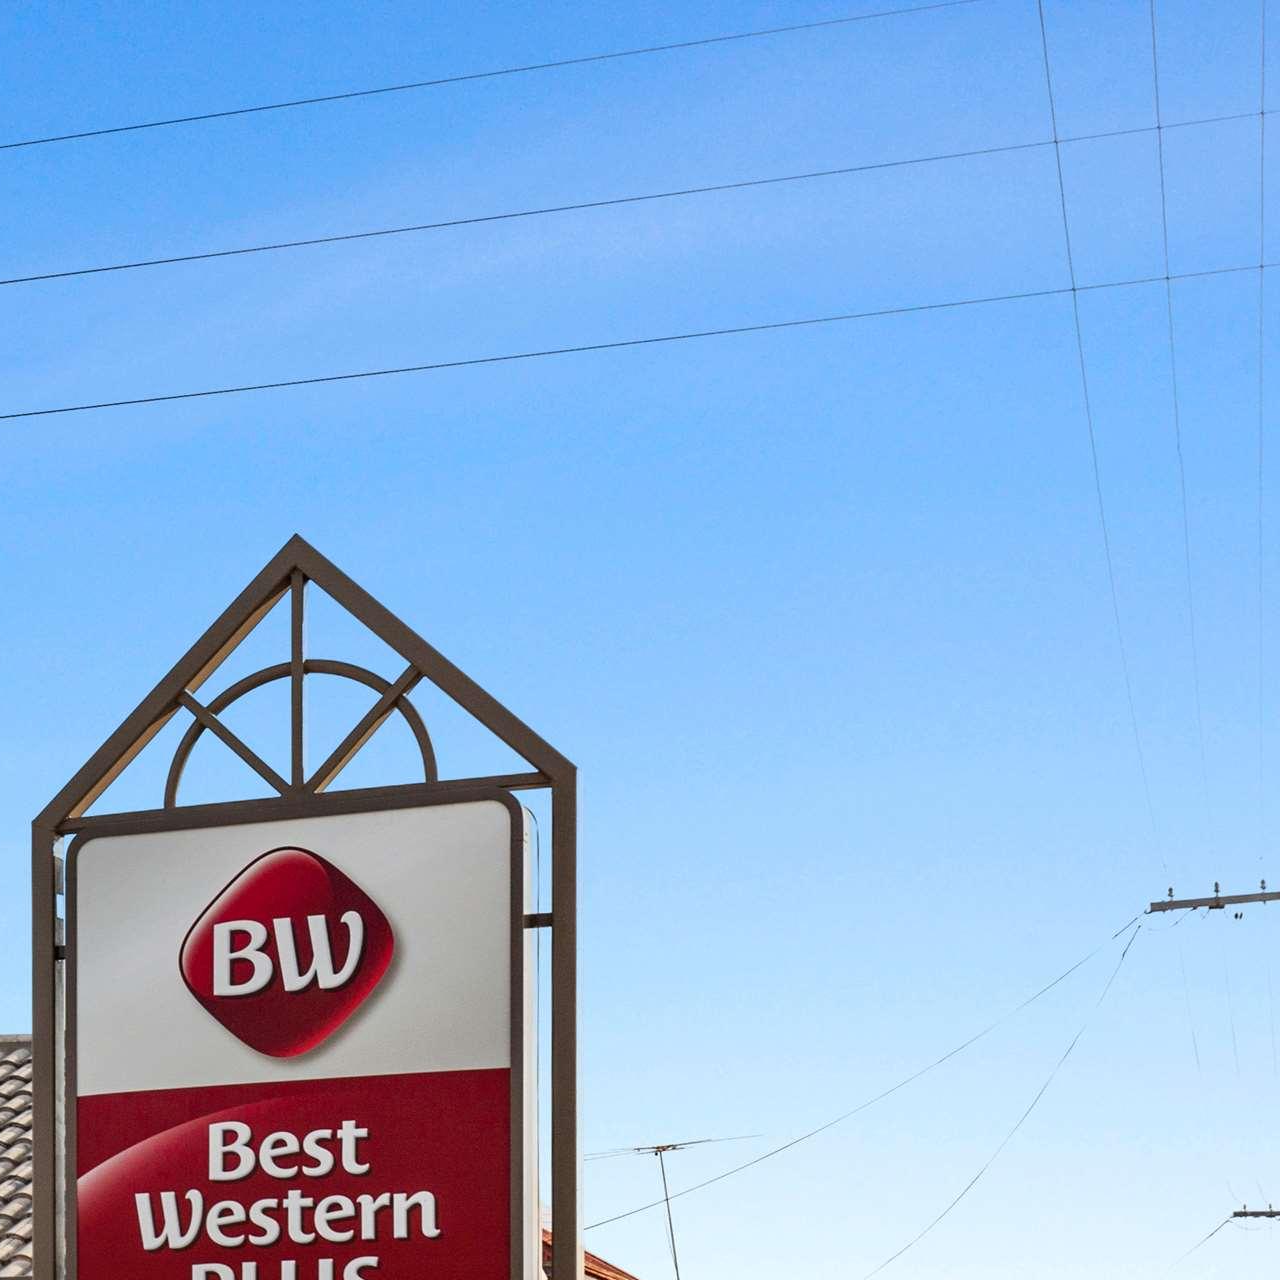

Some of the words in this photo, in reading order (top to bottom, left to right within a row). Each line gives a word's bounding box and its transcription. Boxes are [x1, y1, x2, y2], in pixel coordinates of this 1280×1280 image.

[213, 910, 364, 997] BW
[208, 1119, 370, 1181] Best
[134, 1188, 441, 1251] Western
